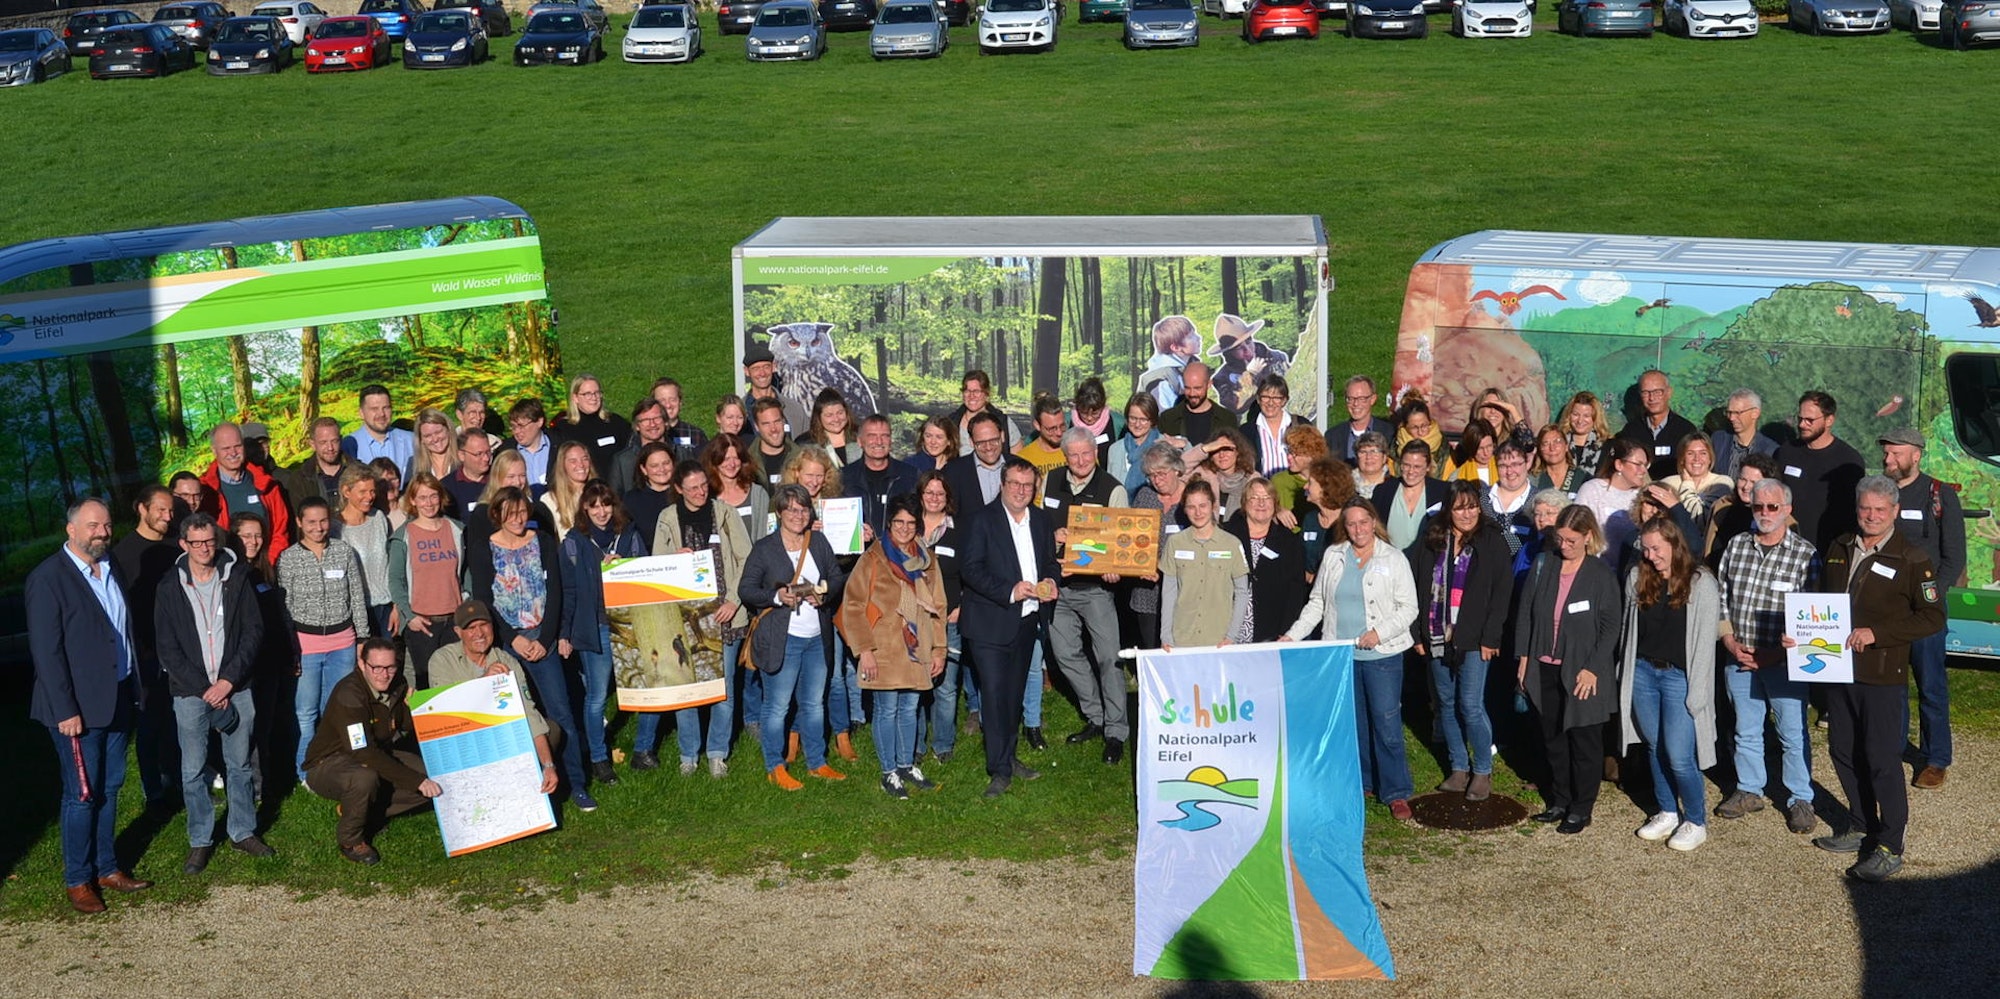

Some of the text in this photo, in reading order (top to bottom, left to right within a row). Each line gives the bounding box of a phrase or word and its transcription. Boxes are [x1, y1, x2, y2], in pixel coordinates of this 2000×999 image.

[759, 265, 888, 275] www.nationalpark-eifel.de
[431, 271, 542, 293] Wald Wasser Wildnis
[32, 308, 117, 326] Nationalpark
[34, 326, 64, 340] Eifel
[417, 539, 441, 550] OH!
[419, 550, 457, 562] CEAN
[1158, 731, 1258, 748] Nationalpark
[1158, 751, 1193, 762] Eifel
